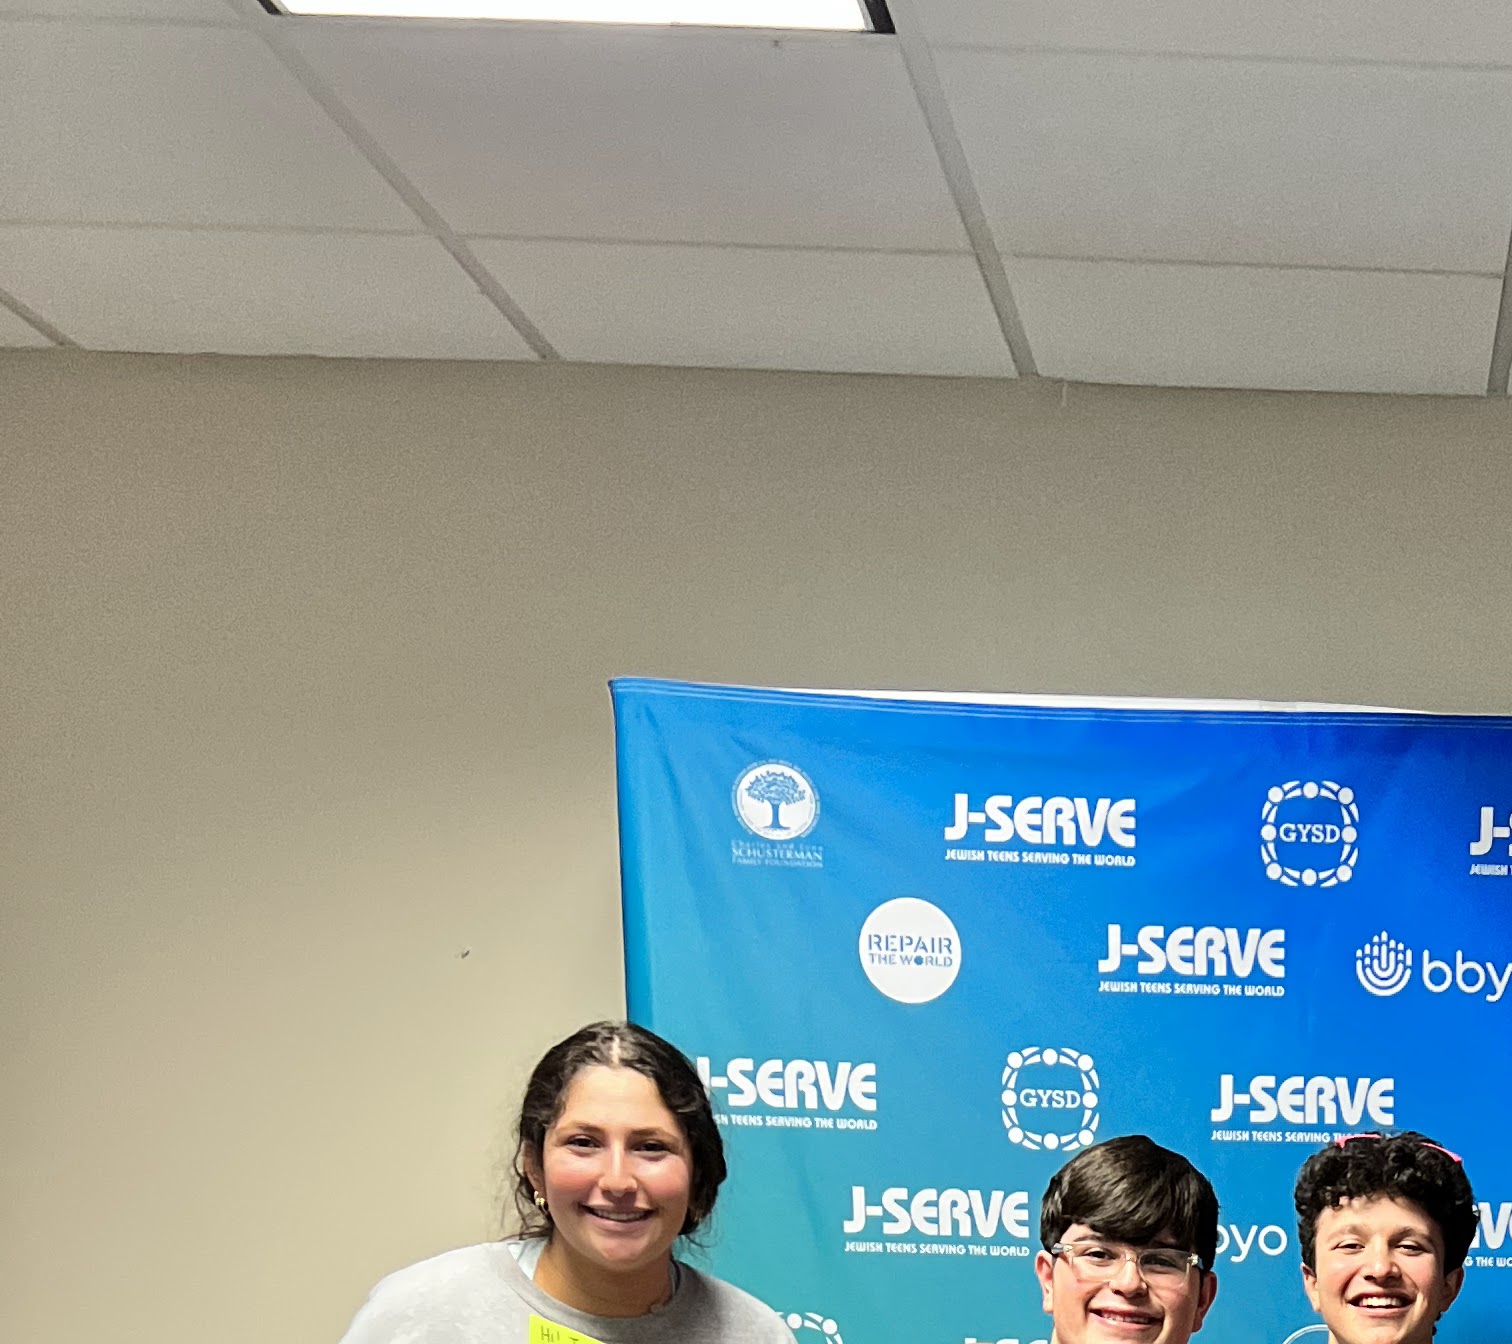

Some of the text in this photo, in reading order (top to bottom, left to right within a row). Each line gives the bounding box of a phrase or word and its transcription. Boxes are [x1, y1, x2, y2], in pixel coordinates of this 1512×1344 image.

[945, 794, 1136, 847] J-SERVE
[1280, 823, 1341, 843] GYSD
[732, 848, 823, 861] SCHUSTERMAN
[945, 848, 1135, 867] JEWISH TEENS SERVING THE WORLD
[1470, 863, 1508, 876] JEWISH
[868, 934, 953, 955] REPAIR
[1098, 924, 1285, 978] J-SERVE
[868, 953, 953, 968] THE WORLD
[1099, 980, 1284, 997] JEWISH TEENS SERVING THE WORLD
[697, 1057, 876, 1111] J-SERVE
[1020, 1089, 1081, 1109] GYSD
[1211, 1075, 1395, 1125] J-SERVE
[730, 1114, 877, 1131] TEENS SERVING THE WORLD
[844, 1186, 1029, 1238] J-SERVE
[845, 1241, 1030, 1257] JEWISH TEENS SERVING THE WORLD
